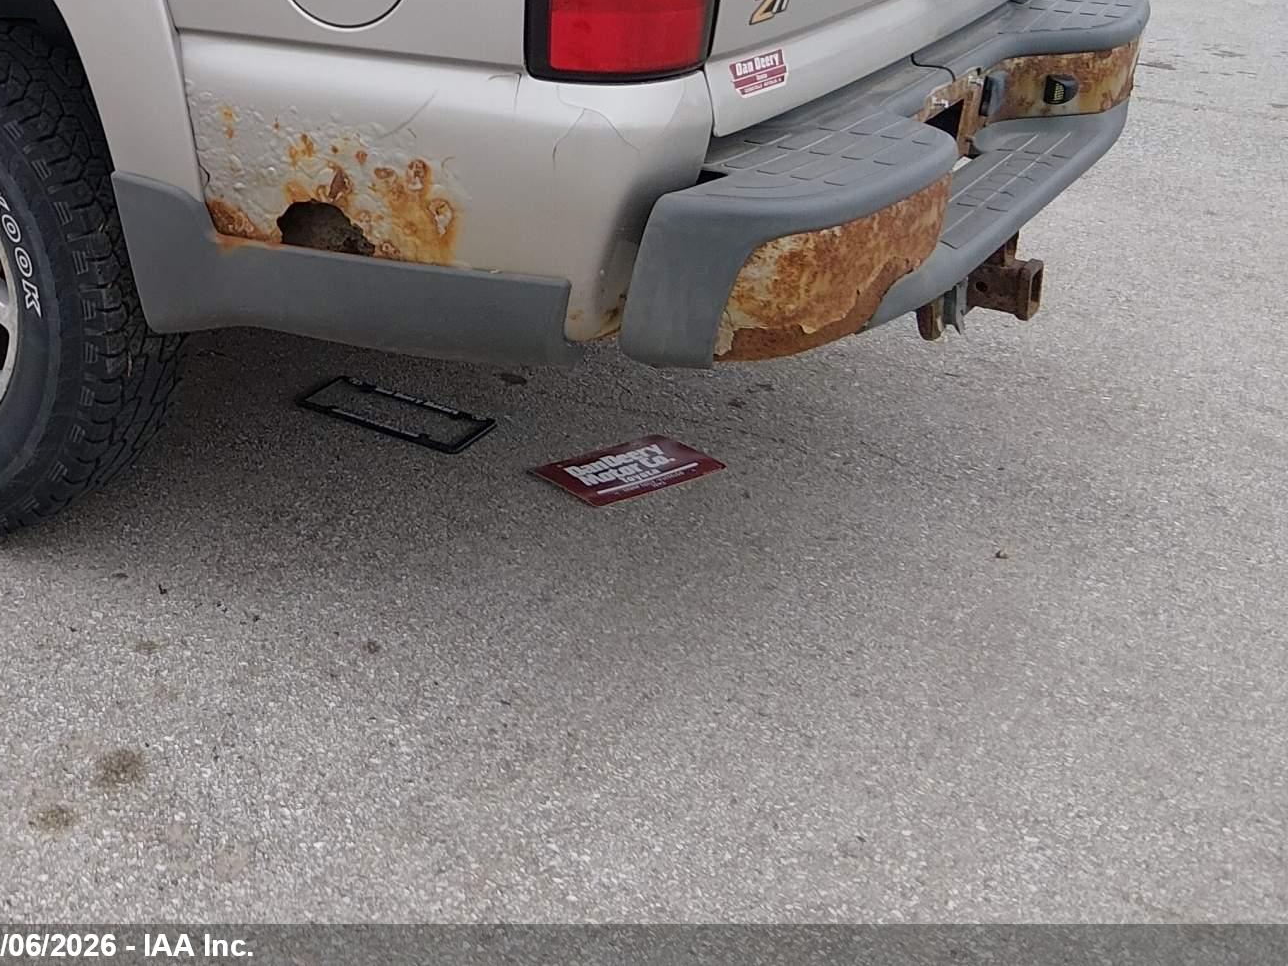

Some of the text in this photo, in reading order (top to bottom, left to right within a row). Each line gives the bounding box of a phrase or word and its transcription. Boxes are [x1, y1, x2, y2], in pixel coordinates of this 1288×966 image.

[735, 52, 781, 76] Dan Deery
[574, 462, 644, 487] Motor
